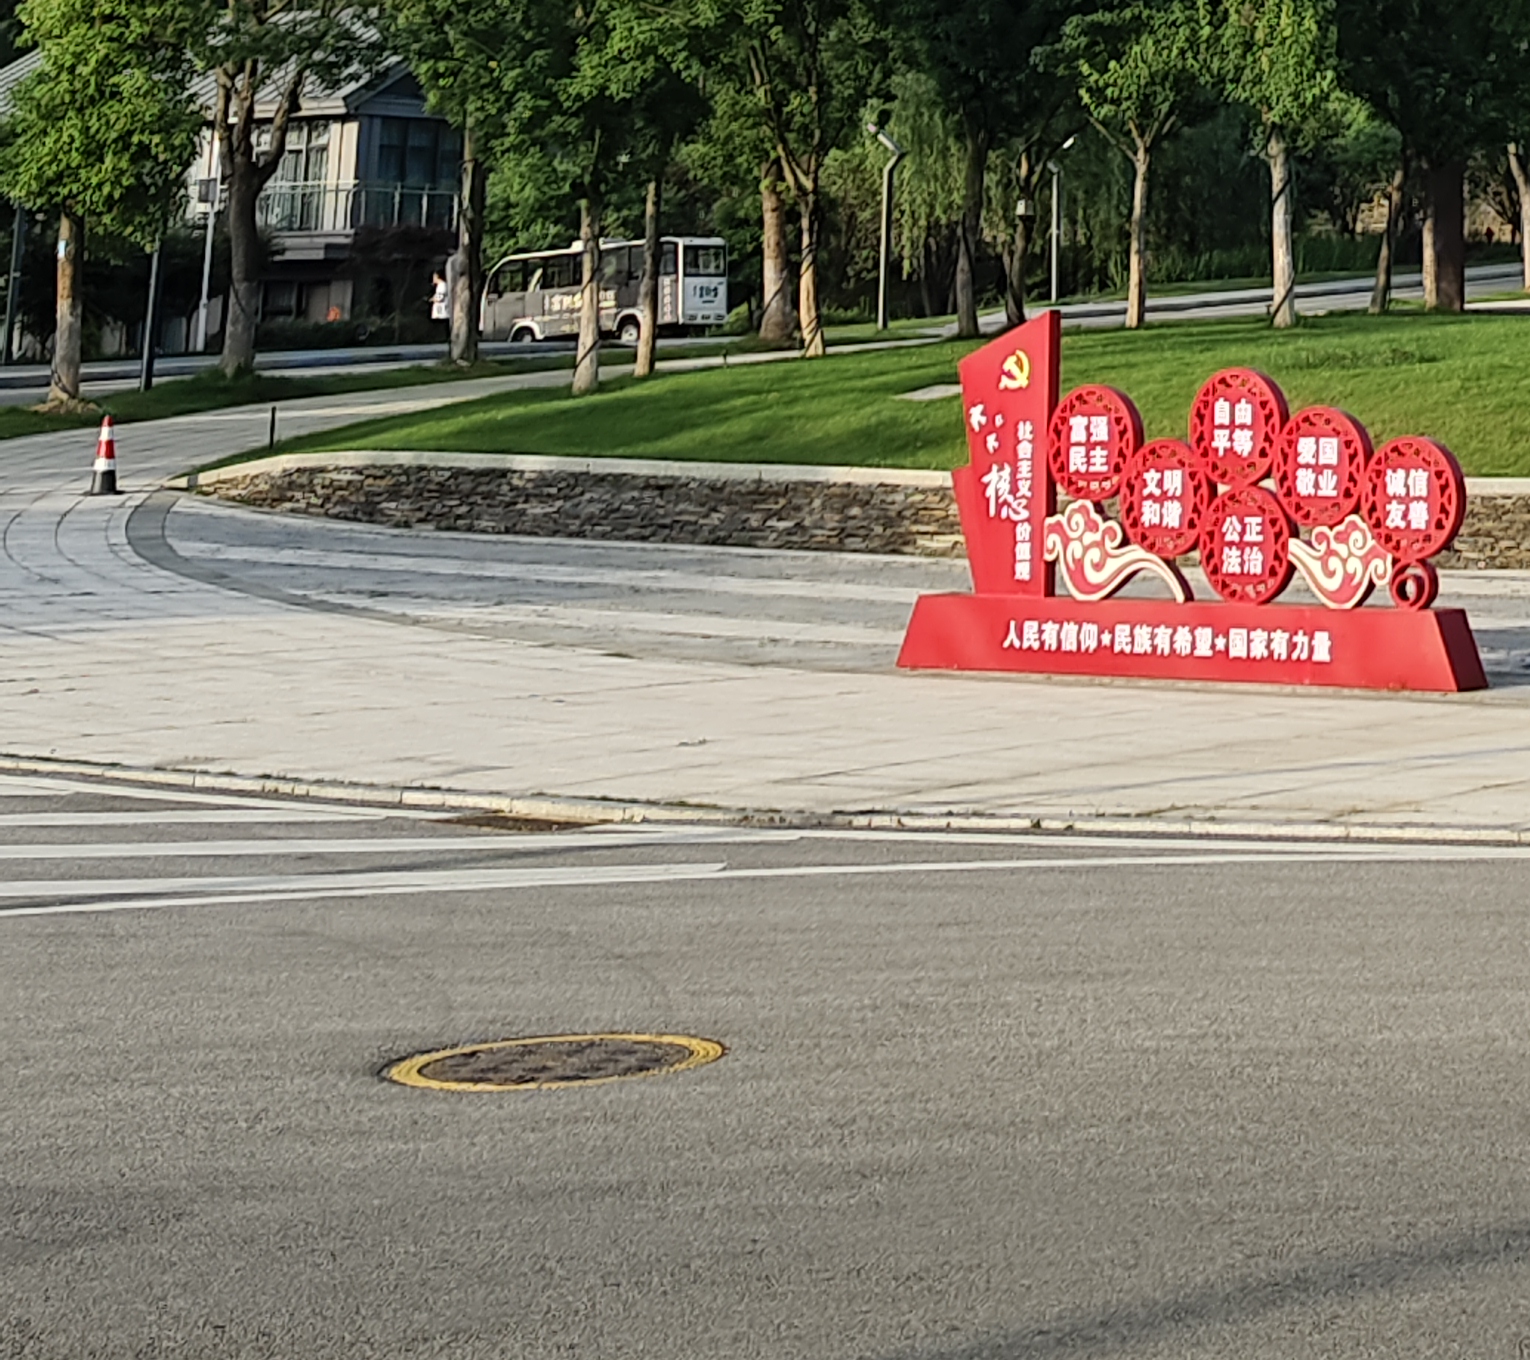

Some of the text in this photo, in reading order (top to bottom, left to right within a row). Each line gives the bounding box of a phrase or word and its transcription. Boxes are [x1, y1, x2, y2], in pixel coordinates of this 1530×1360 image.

[1215, 398, 1252, 425] 自由
[1070, 415, 1108, 443] 富强
[1212, 429, 1253, 457] 平等
[1070, 446, 1108, 472] 民主
[1298, 437, 1338, 465] 爱国
[981, 463, 1031, 521] 核心
[1143, 469, 1182, 496] 文明
[1296, 468, 1337, 496] 敬业
[1385, 469, 1429, 497] 诚信
[1141, 500, 1182, 528] 和谐
[1386, 500, 1429, 529] 友善
[1222, 516, 1263, 542] 公正
[1223, 546, 1263, 574] 法治
[1003, 621, 1331, 662] 人民有信仰 民族有希望 国家有力量
